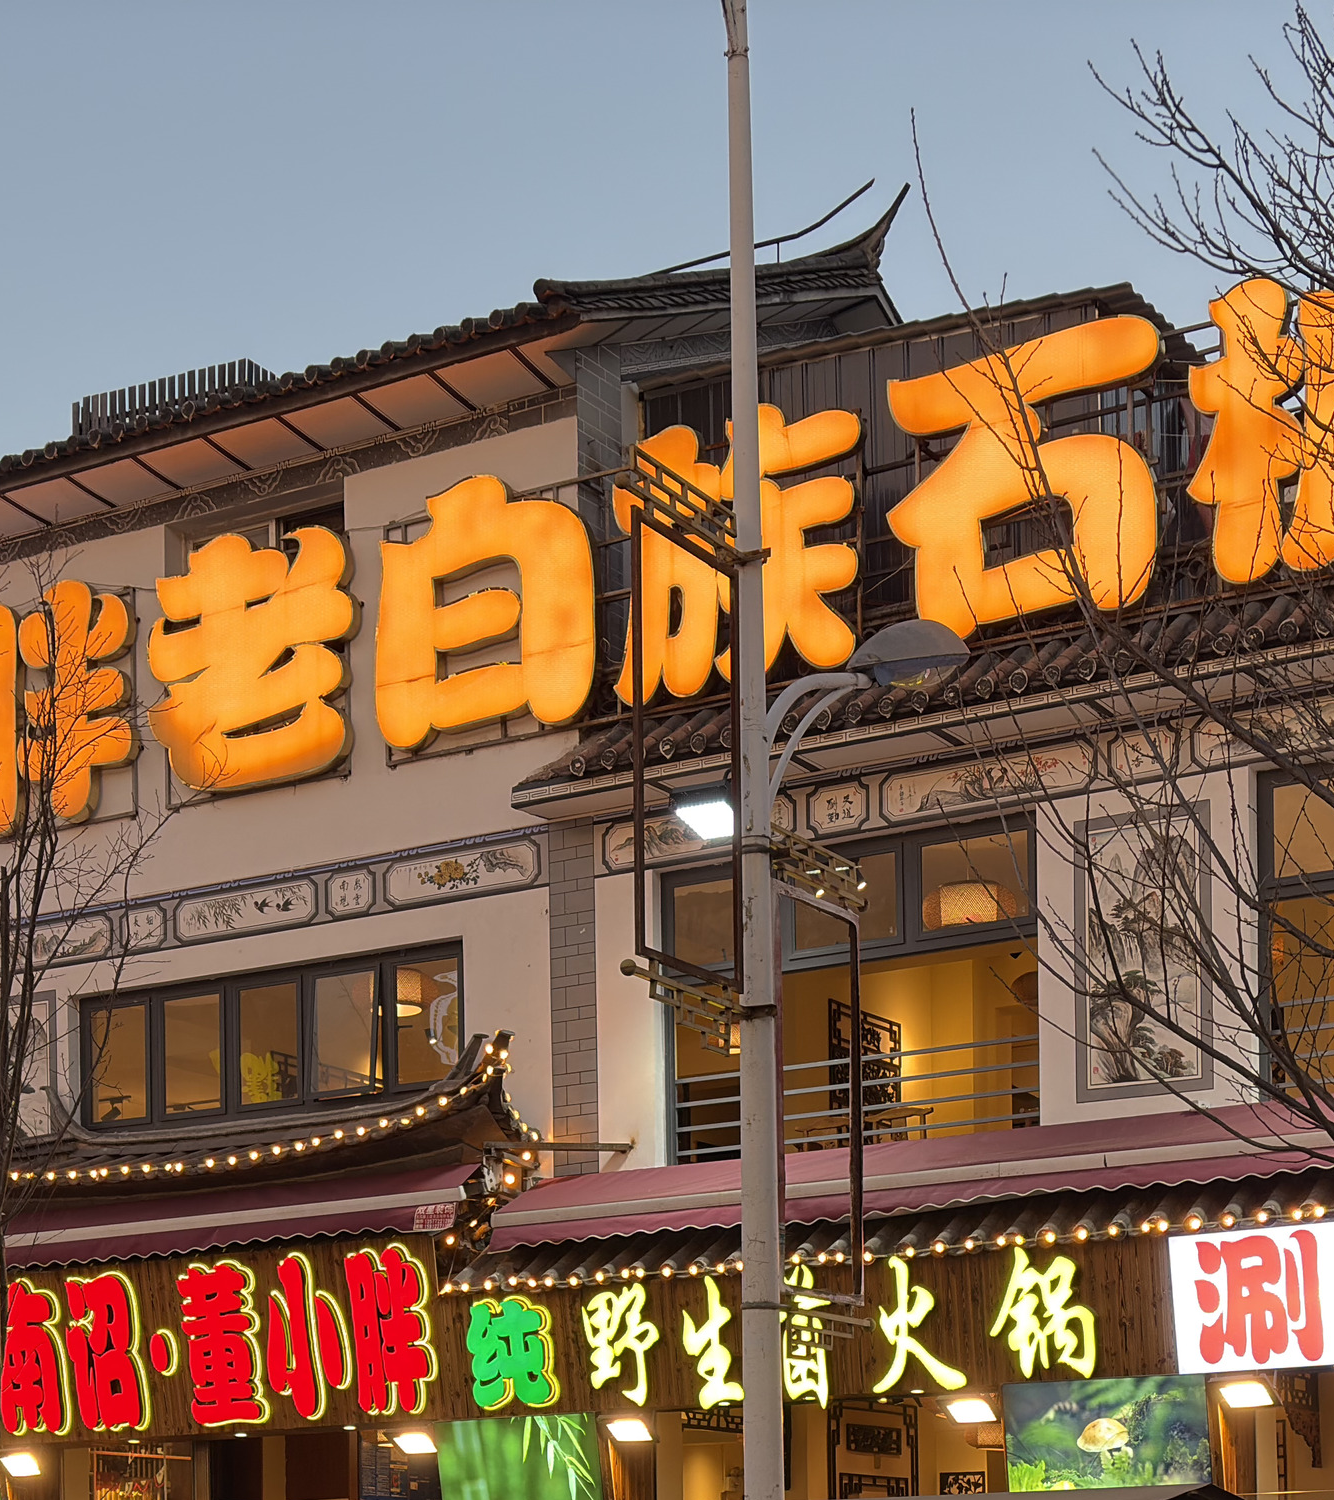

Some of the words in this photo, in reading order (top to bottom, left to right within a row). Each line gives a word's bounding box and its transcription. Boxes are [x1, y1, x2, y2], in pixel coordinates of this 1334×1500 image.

[1, 1242, 439, 1437] 南诏·董小胖
